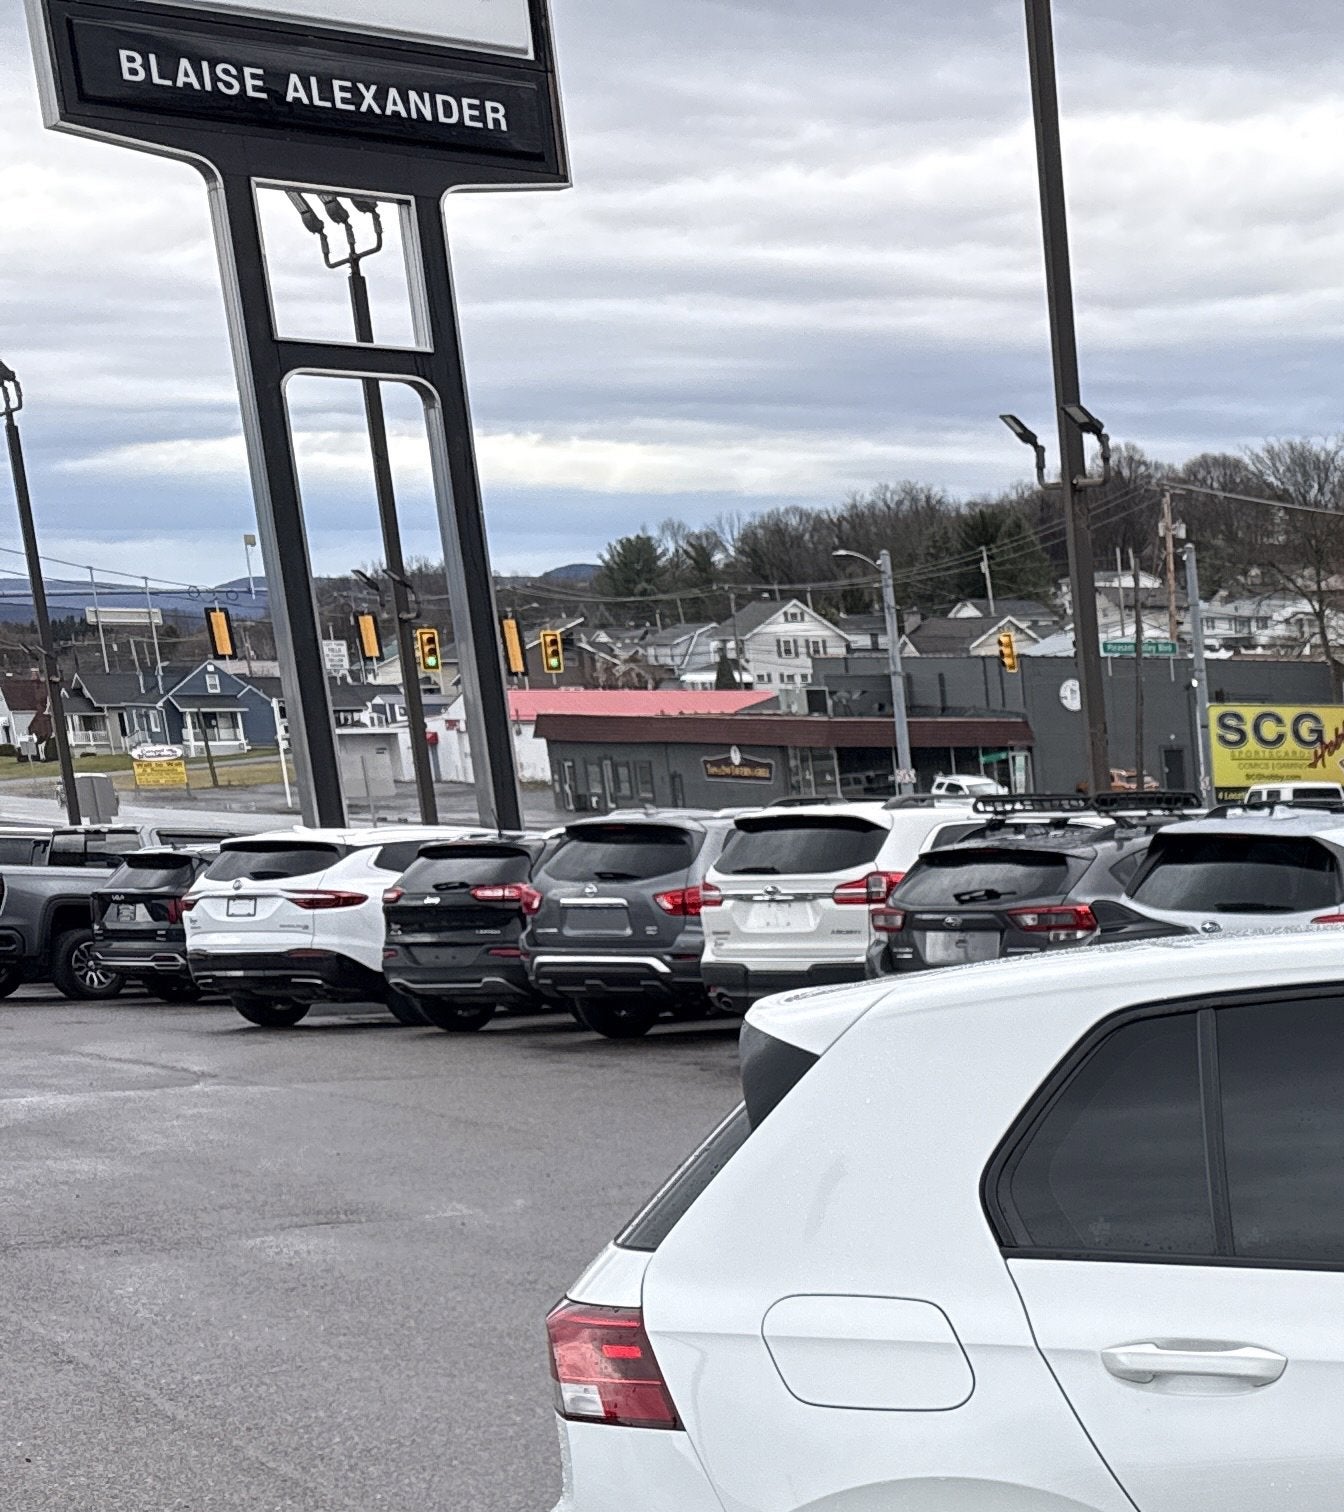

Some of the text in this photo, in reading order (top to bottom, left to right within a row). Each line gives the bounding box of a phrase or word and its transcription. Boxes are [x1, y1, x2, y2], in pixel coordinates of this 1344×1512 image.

[117, 48, 508, 132] BLAISE ALEXANDER
[1216, 710, 1325, 750] SCG
